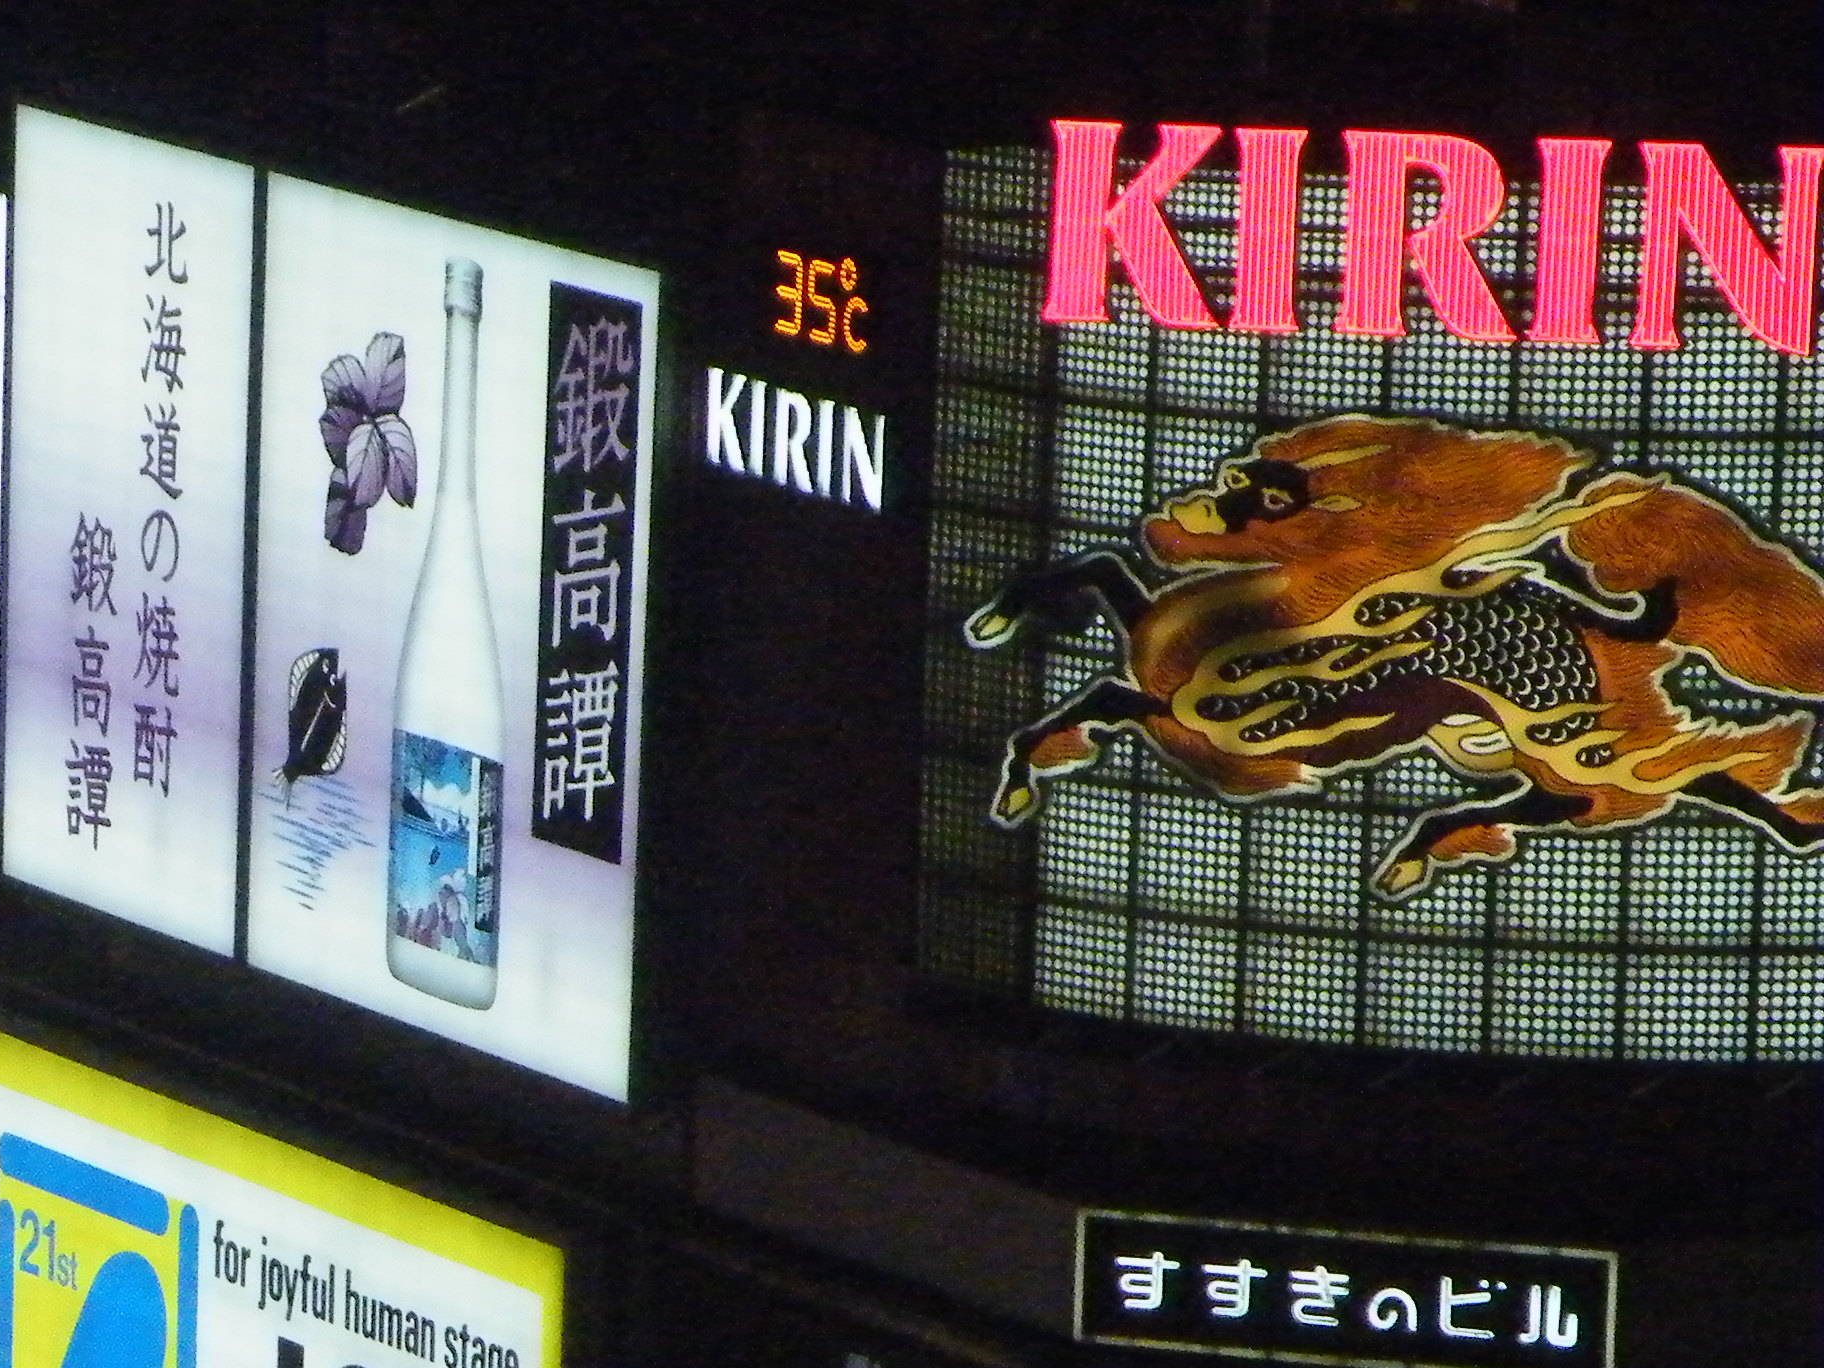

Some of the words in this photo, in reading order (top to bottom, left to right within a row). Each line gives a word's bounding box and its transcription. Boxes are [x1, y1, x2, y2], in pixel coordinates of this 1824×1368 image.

[1043, 117, 1824, 357] KIRIN
[132, 200, 190, 800] 北海道の焼酎
[705, 366, 885, 514] KIRIN
[539, 316, 636, 823] 鍛高譚
[64, 511, 118, 852] 鍛高譚
[18, 1208, 79, 1292] 21st
[211, 1218, 251, 1288] for
[258, 1239, 336, 1325] joyful
[344, 1270, 436, 1364] human
[1113, 1250, 1579, 1351] すすきのビル
